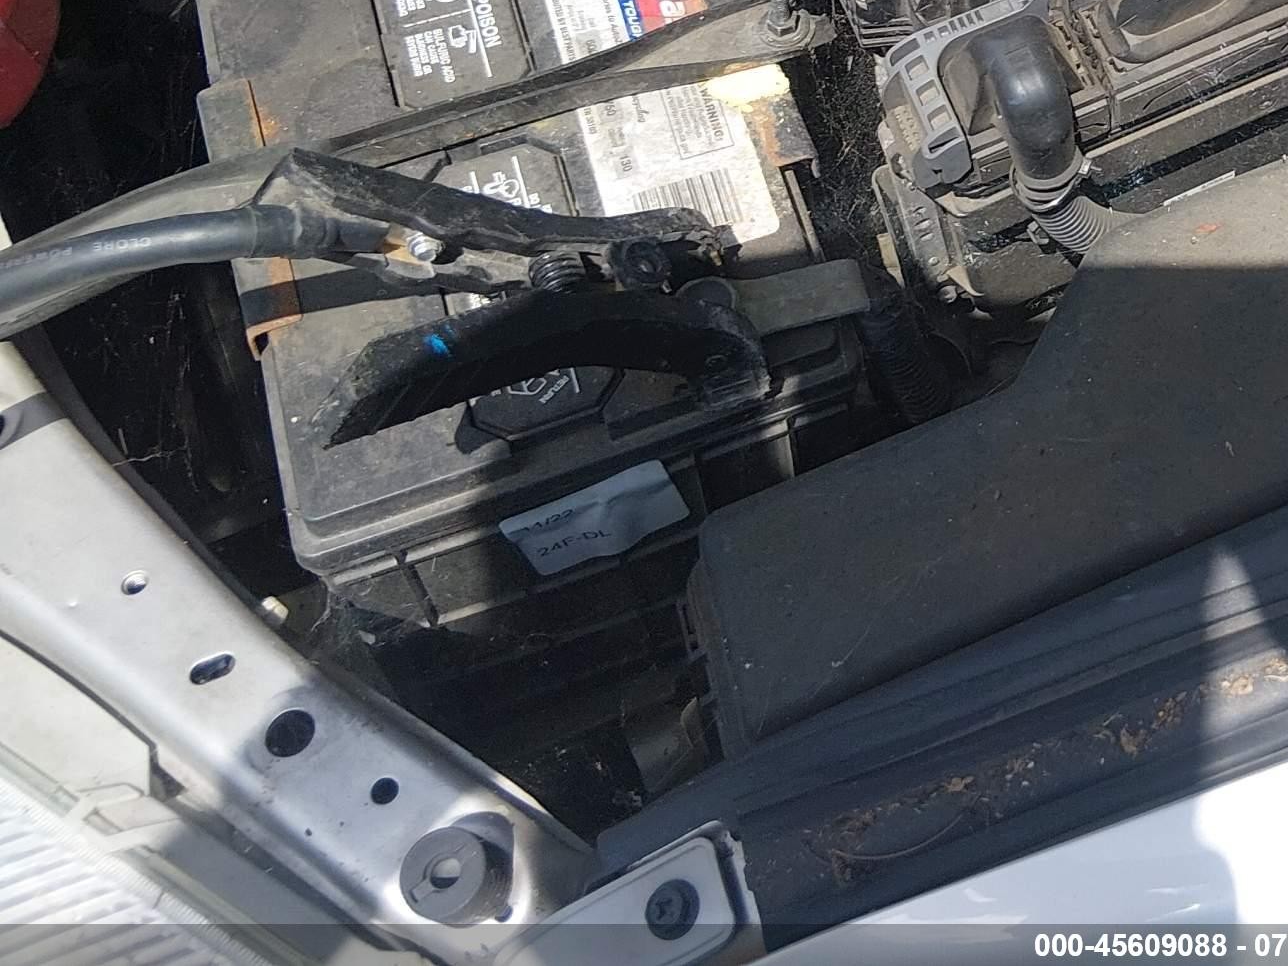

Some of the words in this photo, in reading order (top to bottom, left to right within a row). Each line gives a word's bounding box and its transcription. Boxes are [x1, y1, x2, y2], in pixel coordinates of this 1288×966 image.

[607, 14, 615, 22] to
[431, 28, 451, 65] SULFURIC
[441, 64, 455, 83] ACID
[618, 153, 633, 172] 130
[93, 237, 152, 251] CLORE
[538, 529, 611, 557] 24F-DL
